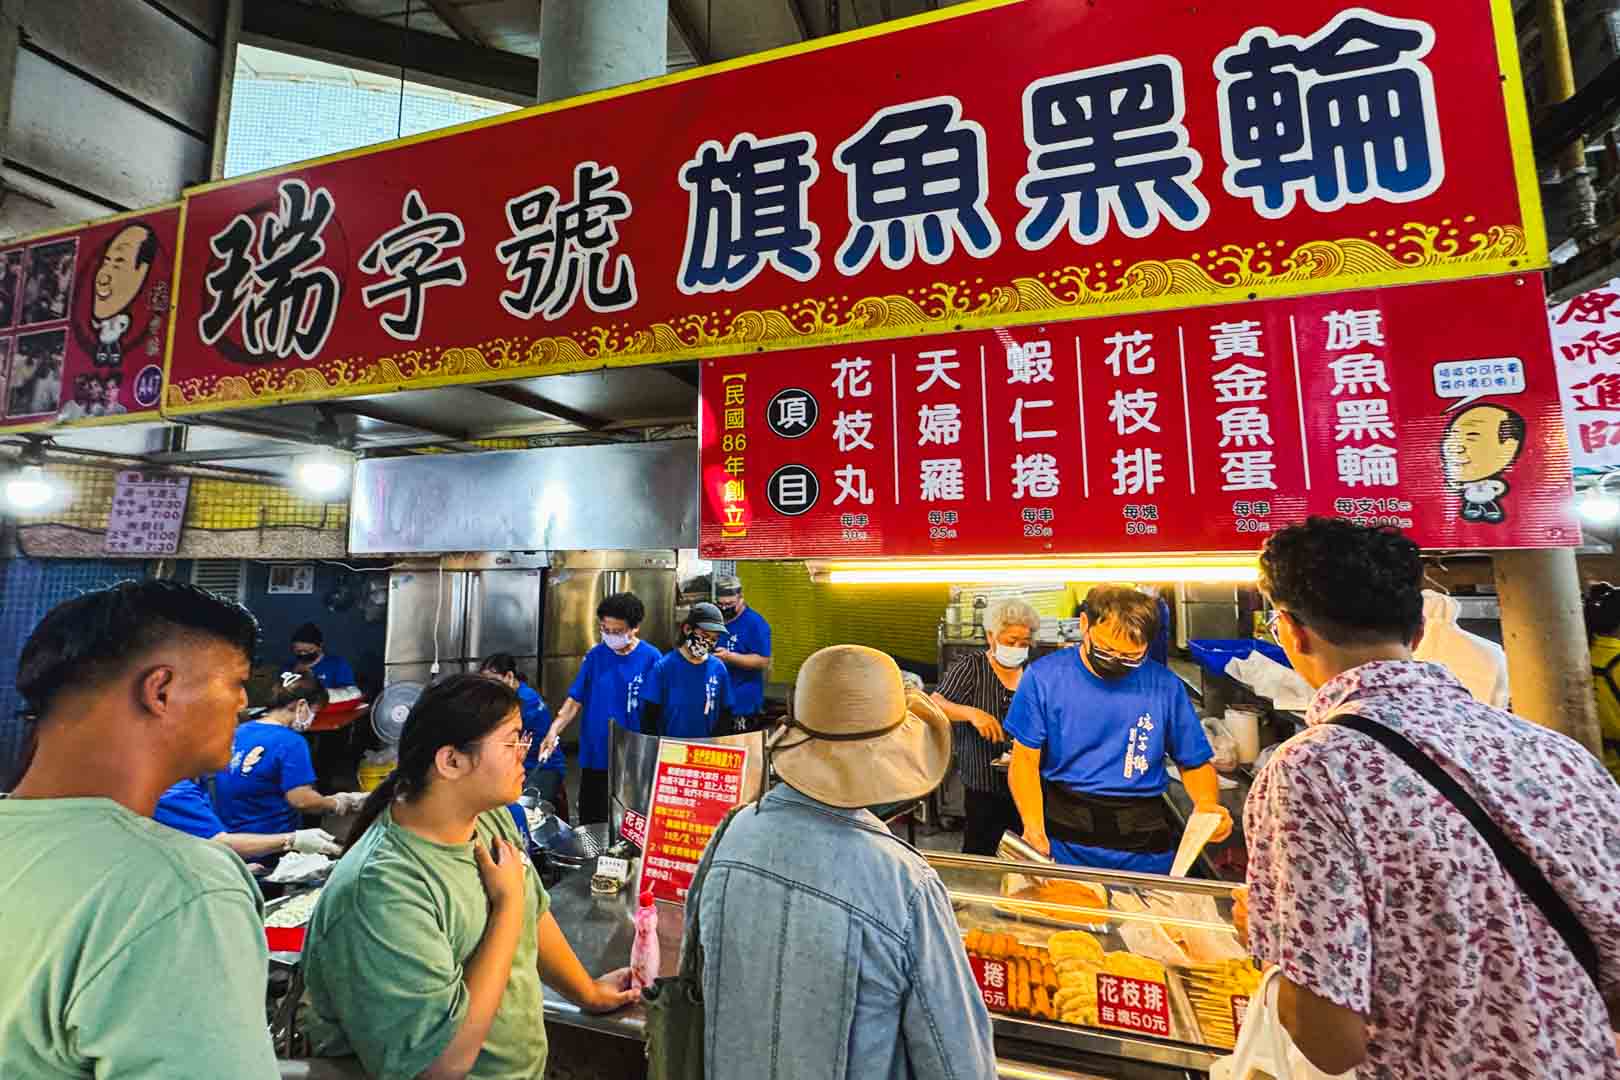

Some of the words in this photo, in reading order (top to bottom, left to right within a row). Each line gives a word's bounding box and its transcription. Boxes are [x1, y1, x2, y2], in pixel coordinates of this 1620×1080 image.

[200, 161, 637, 361] 瑞字號
[675, 7, 1445, 295] 旗魚黑輪
[831, 357, 874, 506] 花枝丸
[916, 349, 964, 503] 天婦羅
[1007, 340, 1060, 500] 蝦仁捲
[1104, 330, 1165, 496] 花枝排
[1209, 320, 1278, 491] 黃金魚蛋
[1321, 309, 1400, 488] 旗魚黑輪
[841, 513, 869, 528] 每串
[928, 511, 958, 525] 每串
[1022, 508, 1054, 523] 每串
[1232, 500, 1270, 516] 每串
[1100, 975, 1164, 1012] 花枝排
